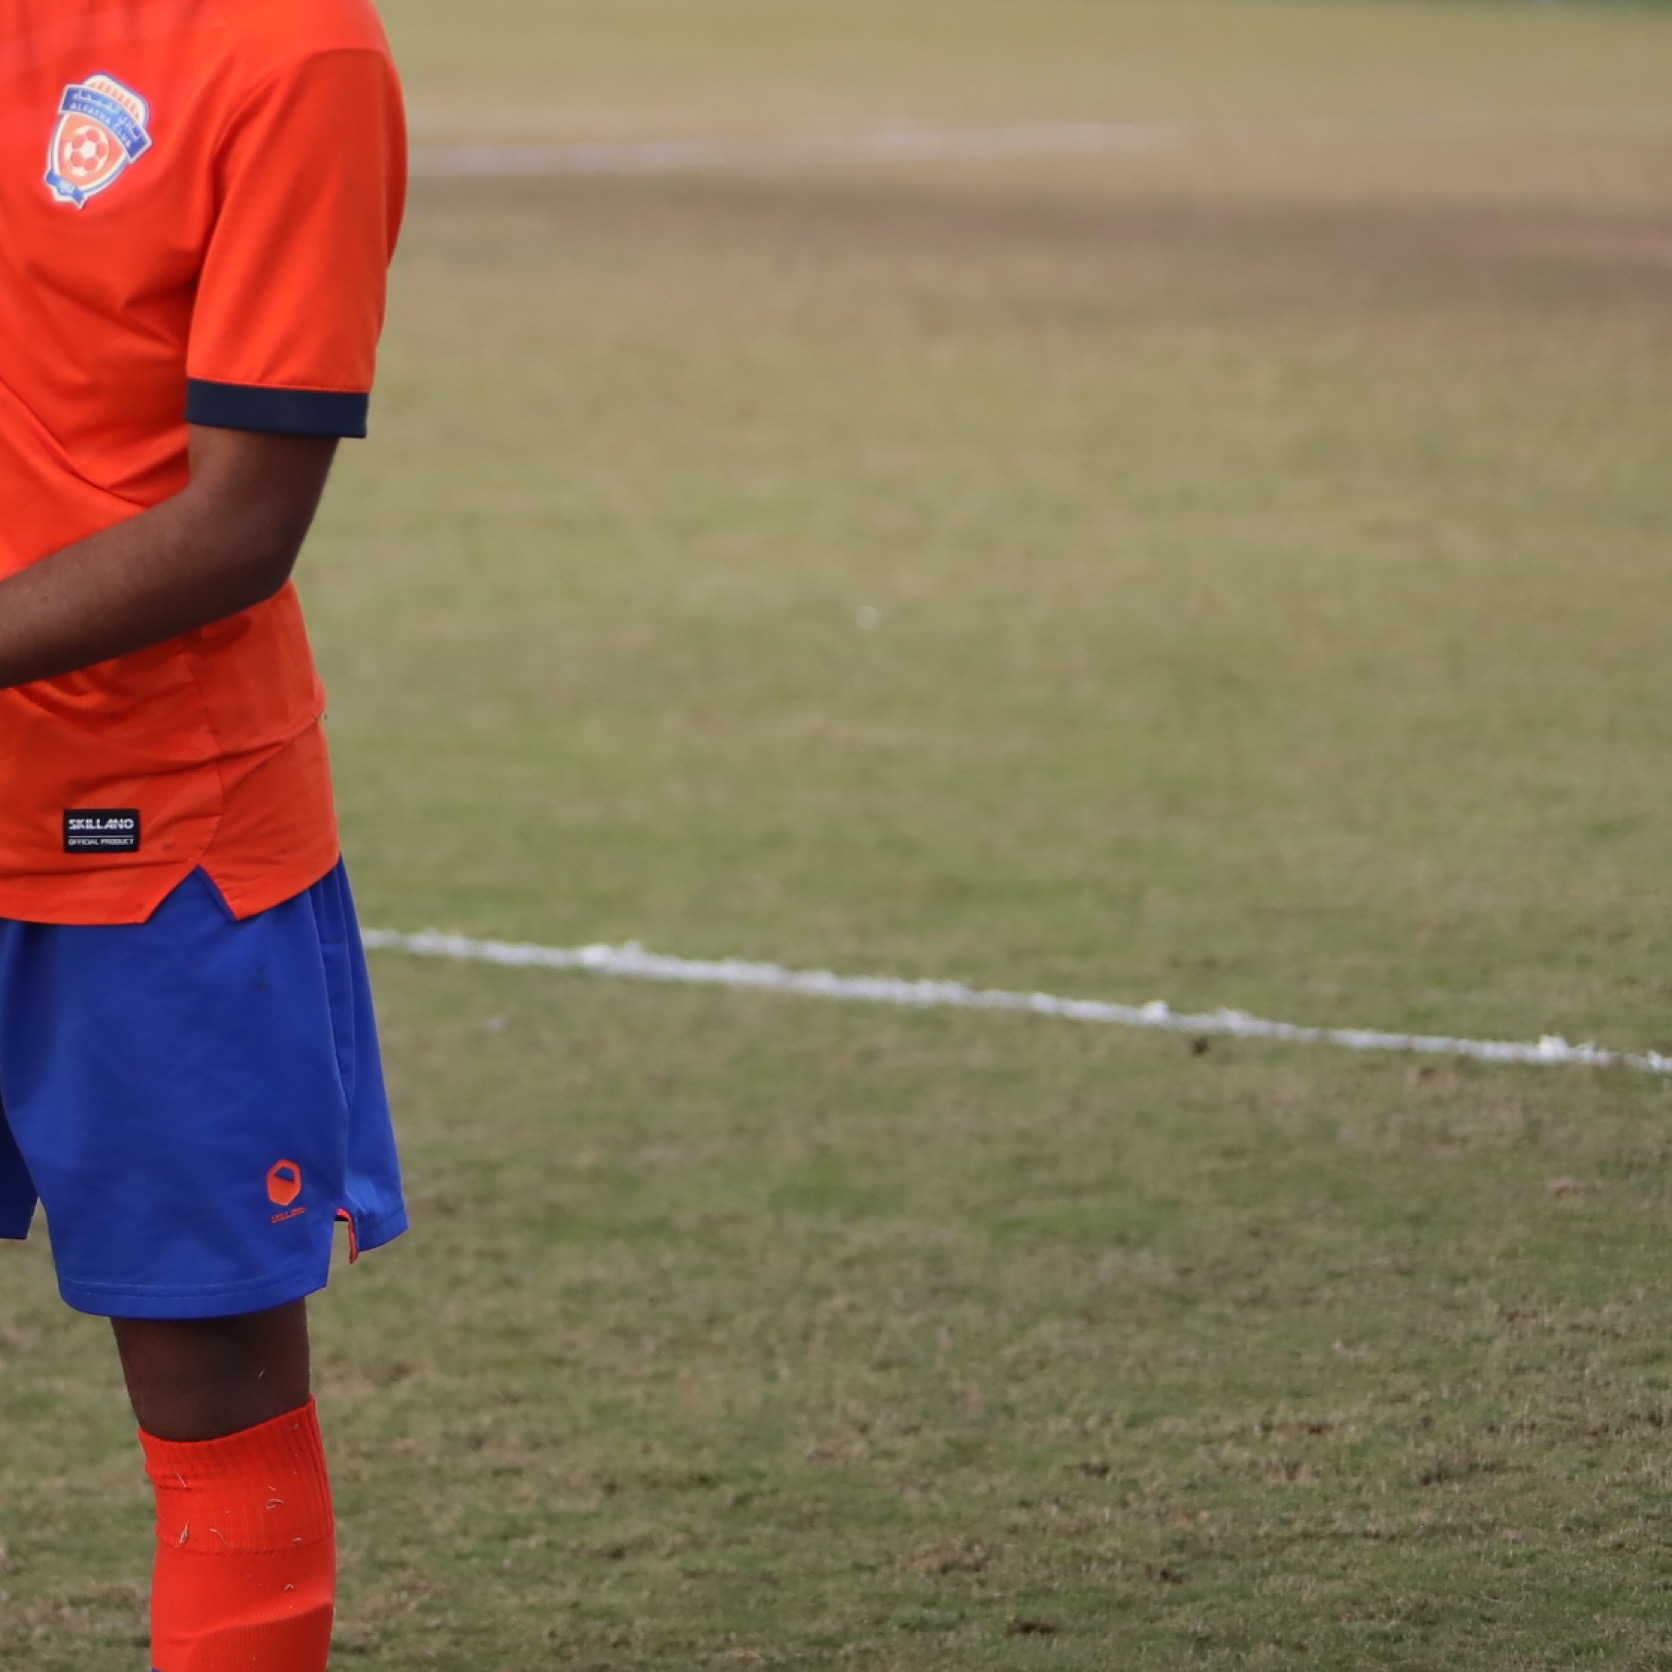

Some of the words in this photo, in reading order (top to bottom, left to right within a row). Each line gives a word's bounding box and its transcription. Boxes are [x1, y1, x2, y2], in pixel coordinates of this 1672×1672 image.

[68, 818, 135, 830] SKILLANO
[68, 838, 100, 846] OFFICIAL
[100, 838, 135, 846] PRODUCT
